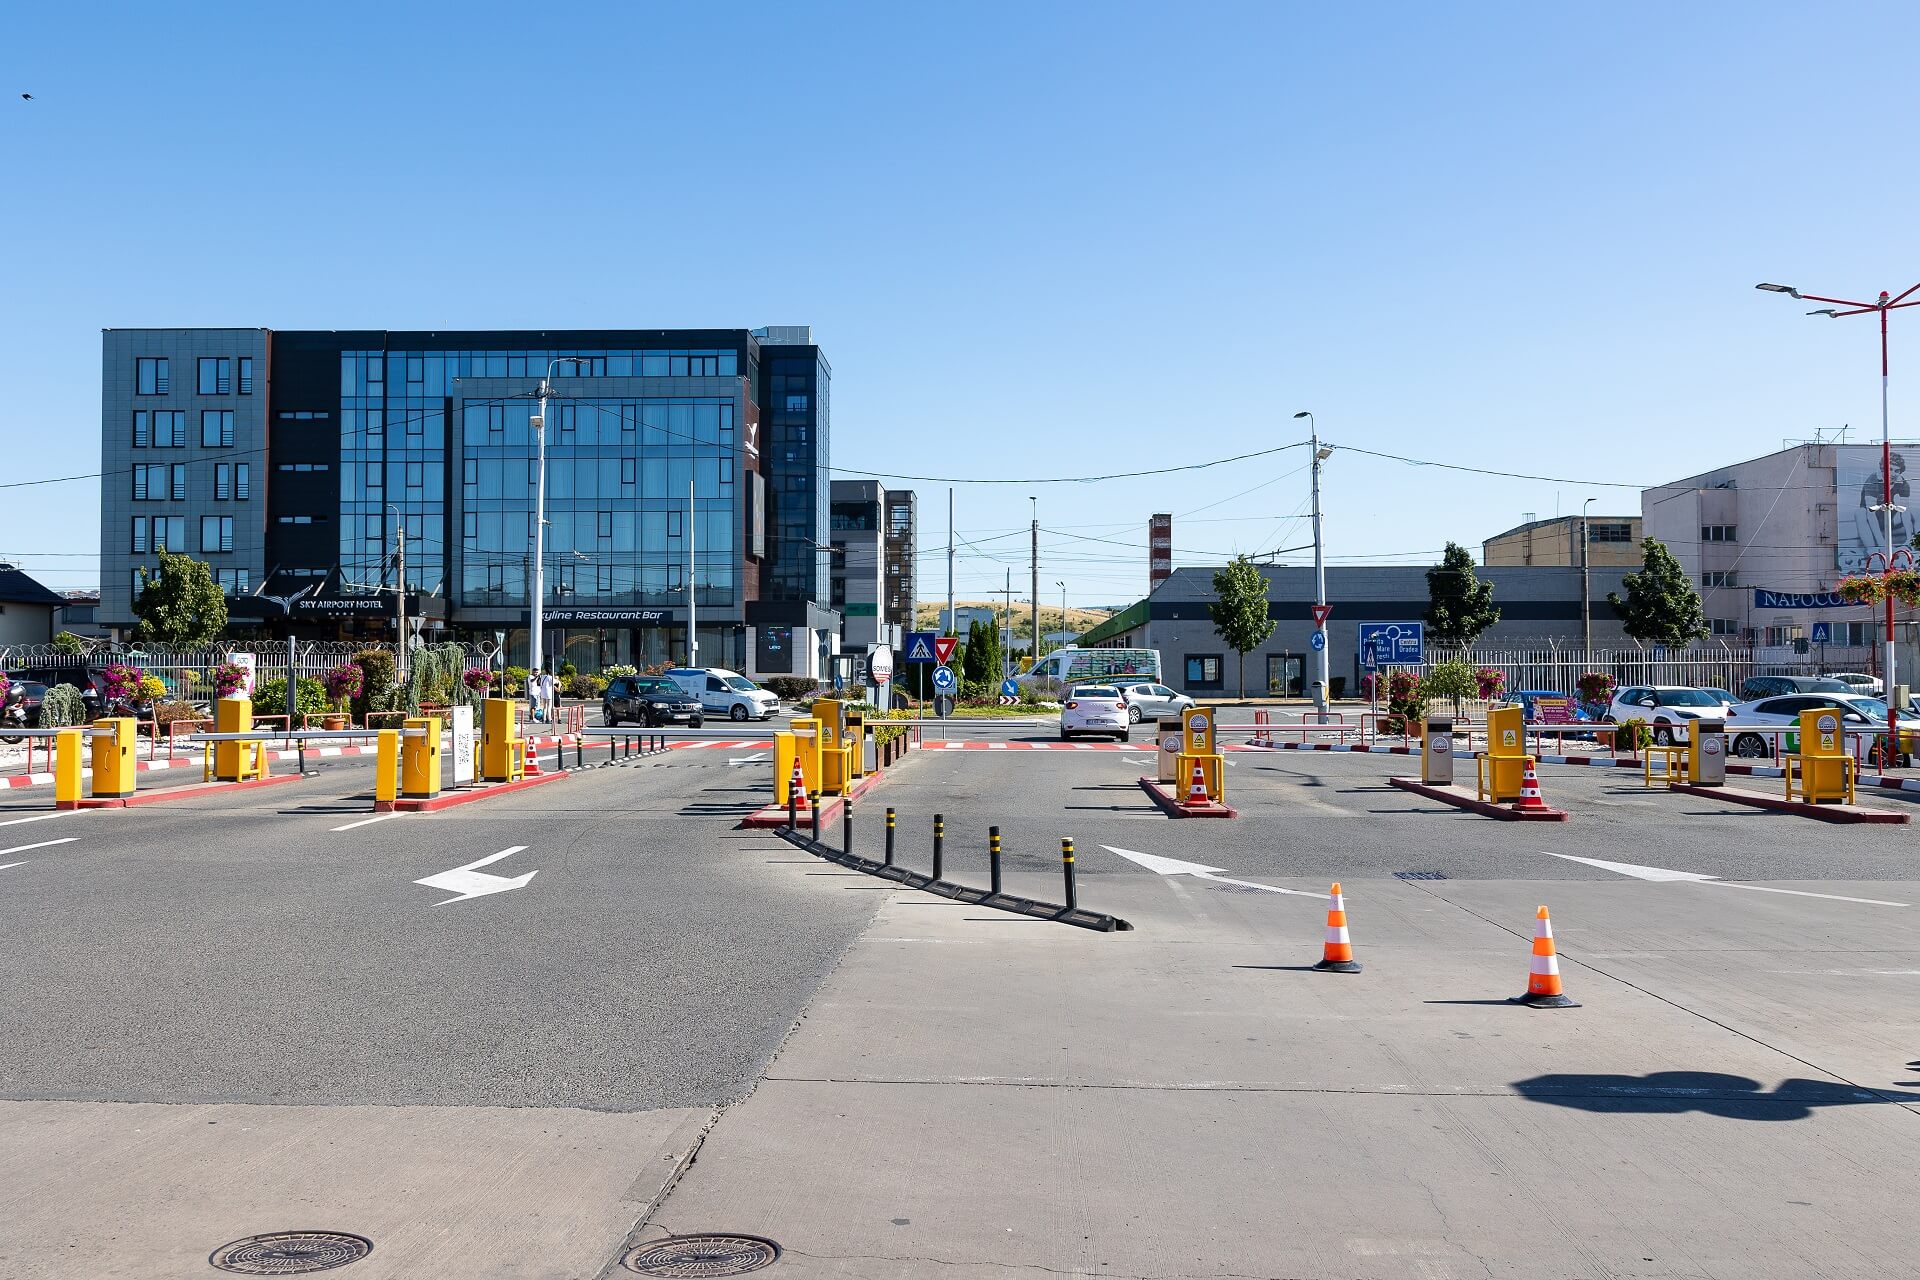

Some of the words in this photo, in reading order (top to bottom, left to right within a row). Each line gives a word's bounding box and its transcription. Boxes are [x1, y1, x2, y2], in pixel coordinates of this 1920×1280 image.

[300, 601, 316, 609] SKY
[317, 601, 354, 609] AIRPORT
[356, 601, 383, 609] HOTEL
[542, 610, 572, 621] yline
[576, 611, 641, 620] Restaurant
[642, 611, 663, 620] Bar
